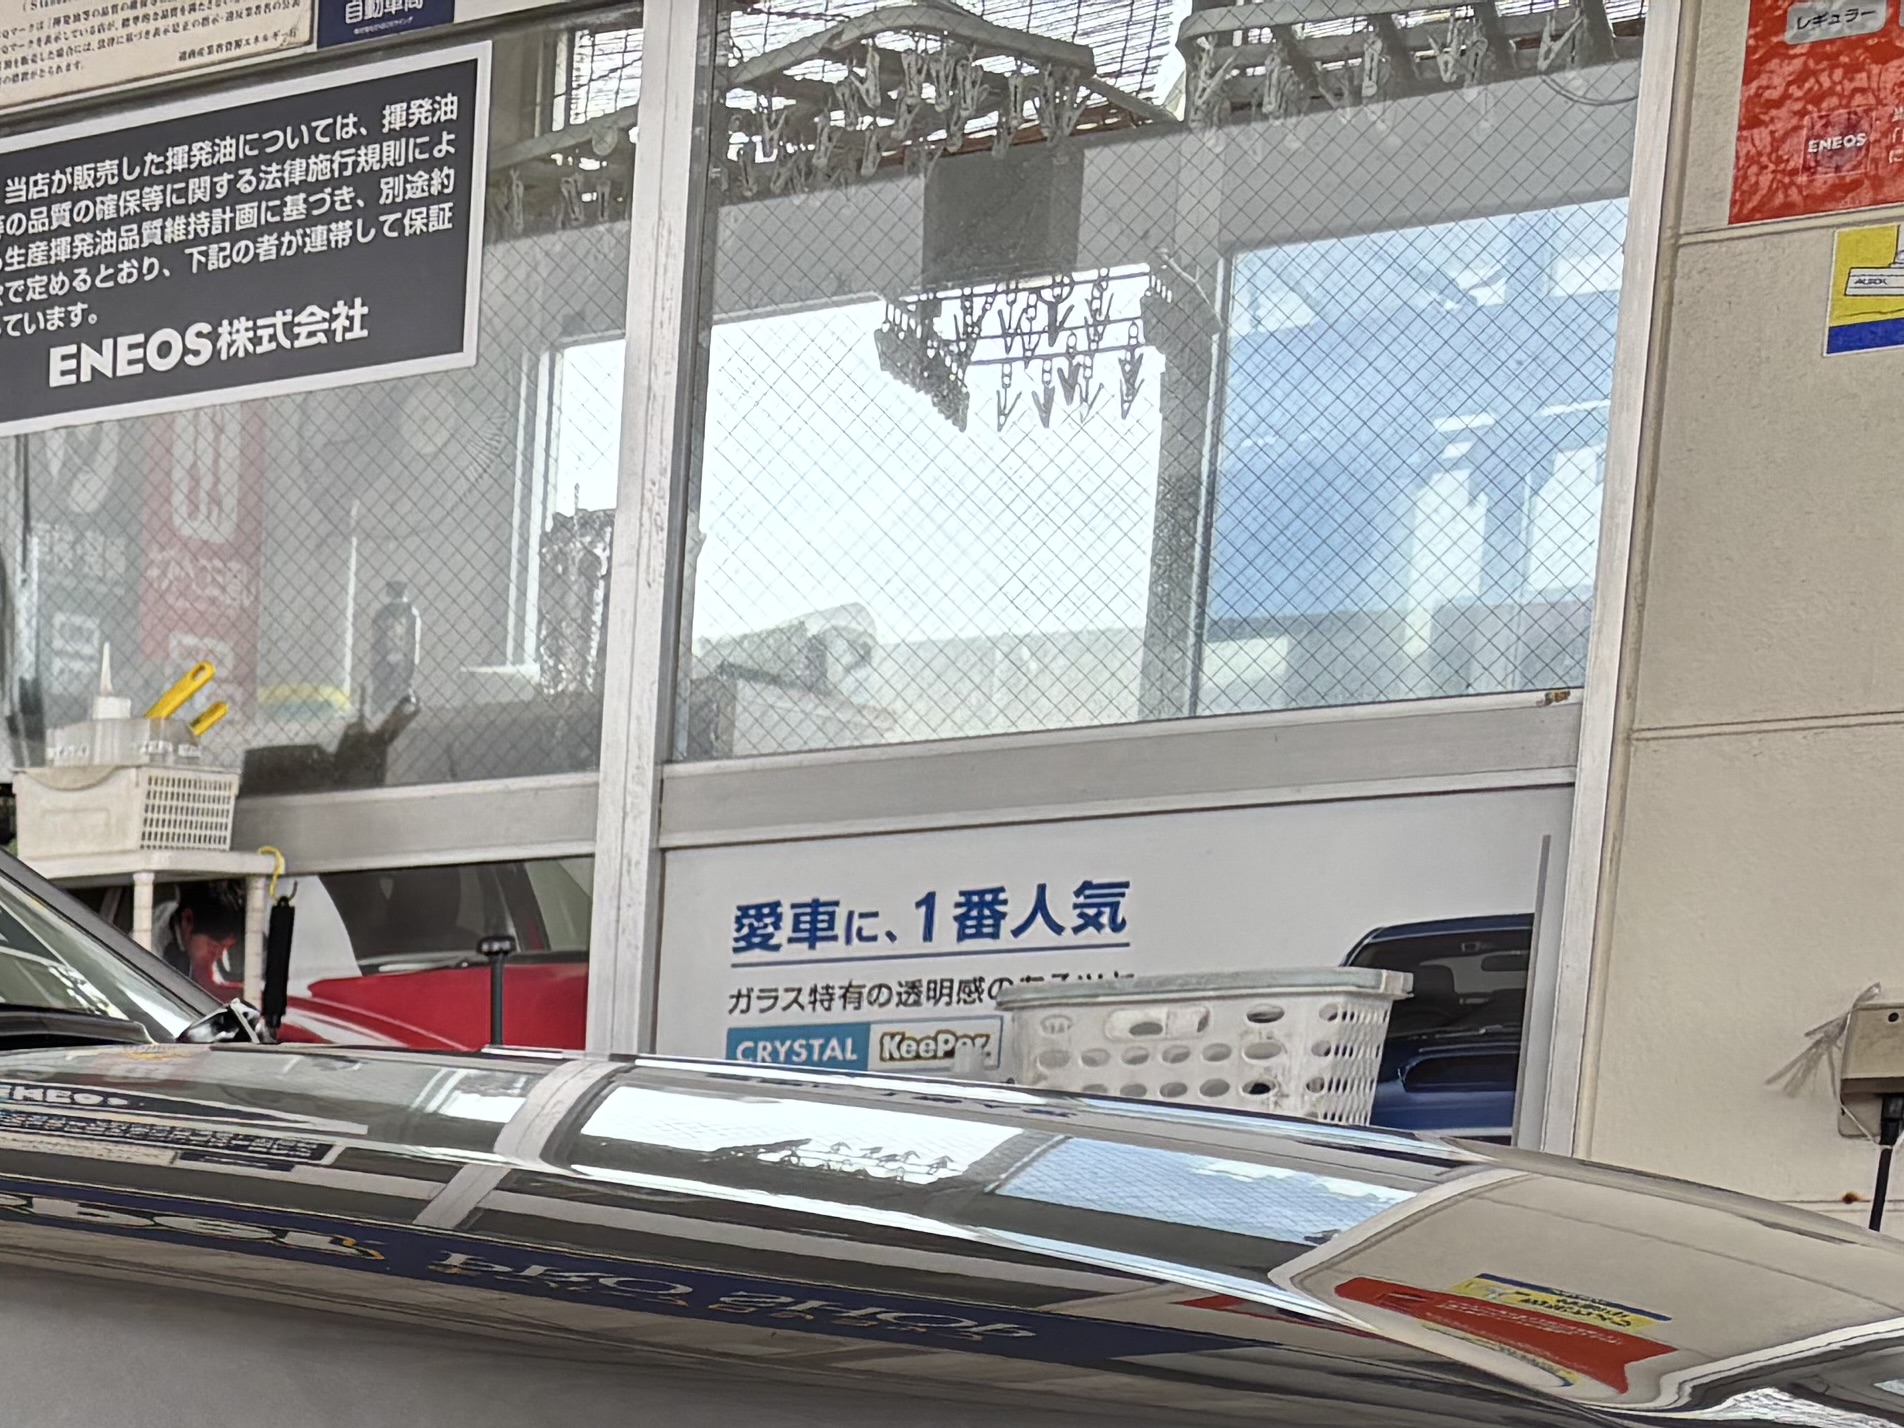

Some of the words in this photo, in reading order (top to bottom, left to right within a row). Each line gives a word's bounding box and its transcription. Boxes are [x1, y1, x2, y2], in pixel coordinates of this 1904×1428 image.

[1796, 8, 1876, 30] レギュラー
[4, 93, 459, 205] 当店が販売した揮発油については、揮発油
[1807, 133, 1868, 153] ENEOS
[47, 297, 370, 387] ENEOS株式会社
[732, 880, 1131, 954] 愛車に、1番人気
[735, 1037, 858, 1066] CRYSTAL
